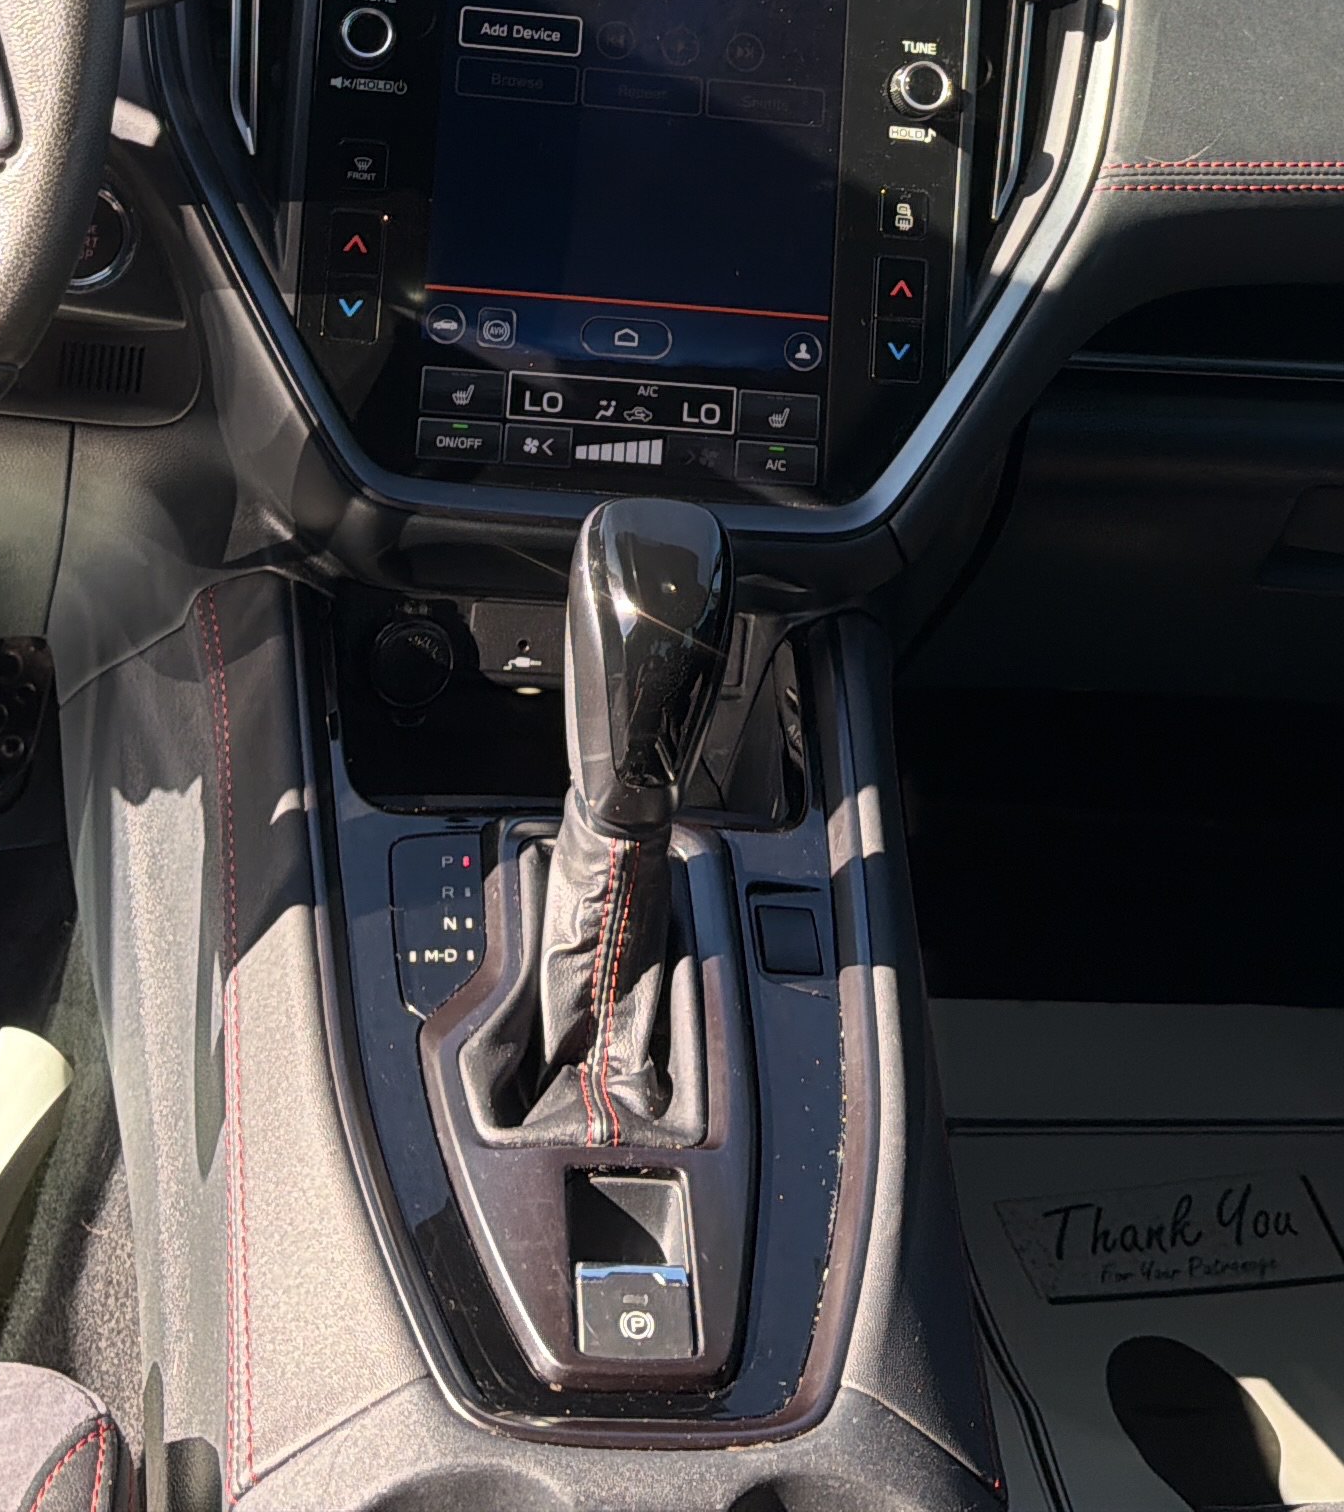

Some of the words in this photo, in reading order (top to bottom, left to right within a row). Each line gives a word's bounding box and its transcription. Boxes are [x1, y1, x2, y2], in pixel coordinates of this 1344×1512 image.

[481, 21, 508, 38] Add
[513, 24, 561, 43] Device
[902, 40, 937, 56] TUNE
[890, 128, 925, 140] HOLD
[347, 170, 376, 181] FRONT
[488, 324, 505, 336] AVH
[637, 385, 659, 399] A/C
[524, 390, 563, 414] LO
[682, 402, 721, 425] LO
[436, 436, 483, 451] ON/OFF
[766, 458, 787, 472] A/C
[441, 855, 454, 868] P
[441, 886, 455, 899] R
[443, 916, 457, 931] N
[424, 948, 459, 963] M-D
[1042, 1193, 1202, 1260] Thank
[1216, 1183, 1299, 1246] You
